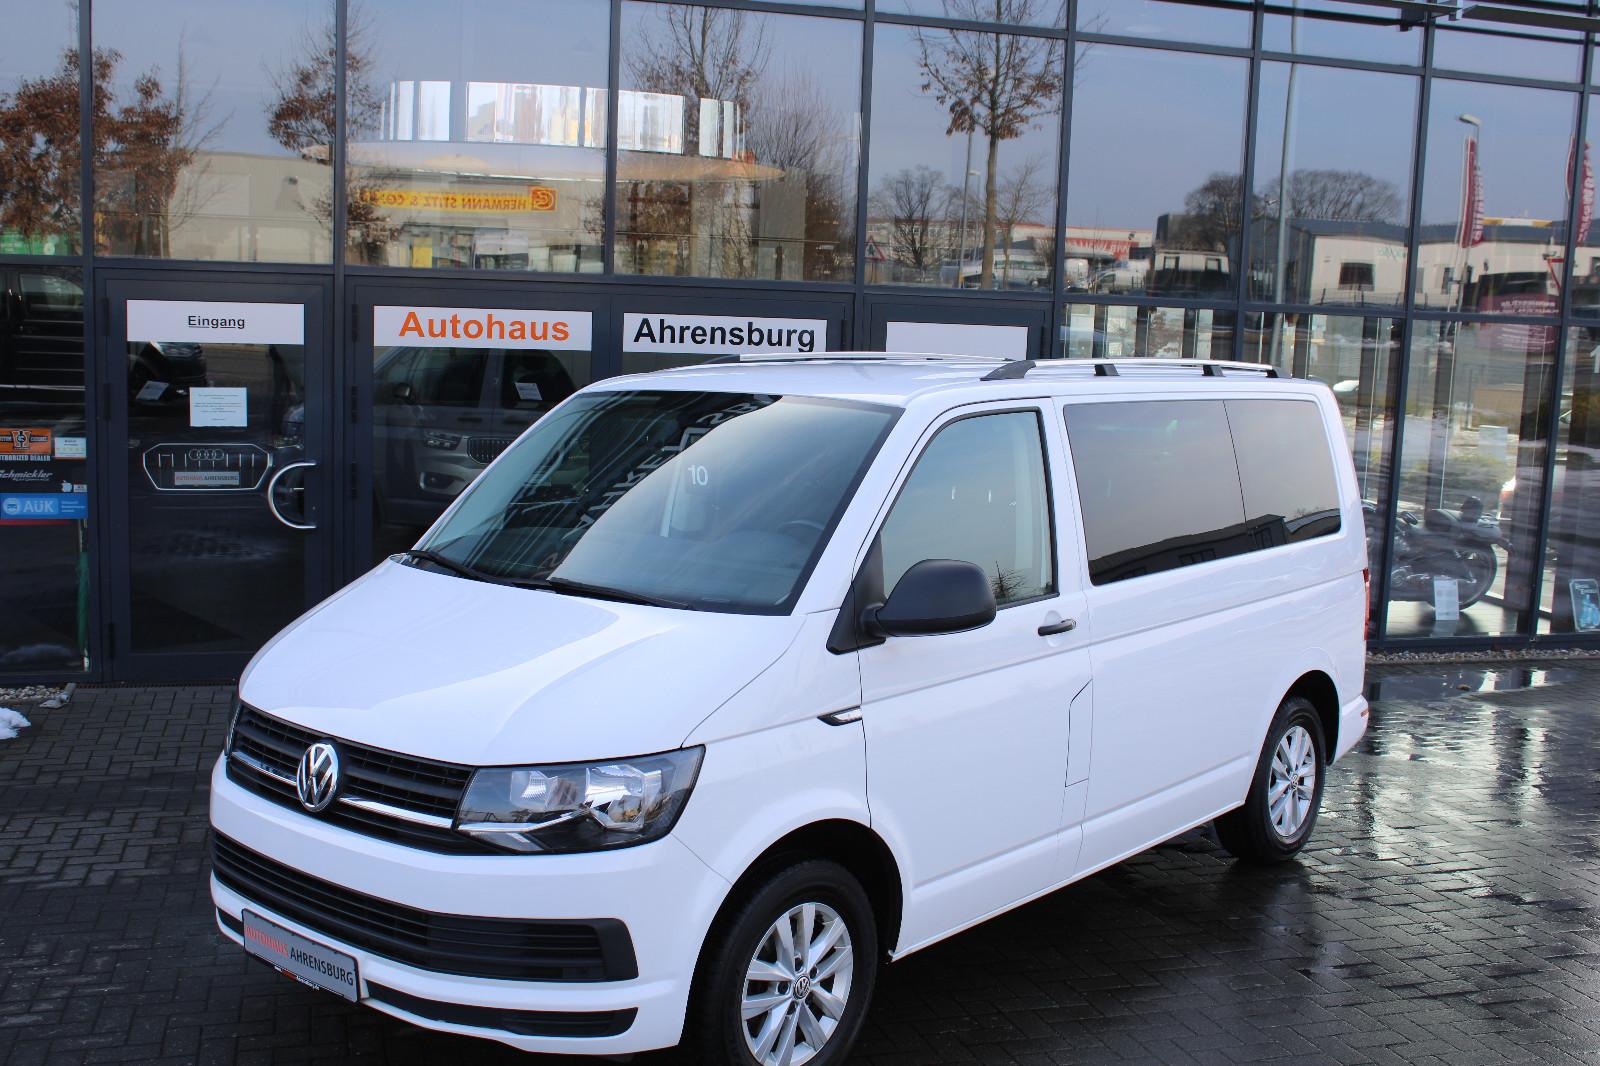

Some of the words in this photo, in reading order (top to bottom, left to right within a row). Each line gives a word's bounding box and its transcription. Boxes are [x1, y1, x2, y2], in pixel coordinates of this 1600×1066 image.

[188, 314, 246, 329] Eingang
[398, 311, 570, 341] Autohaus
[633, 317, 816, 353] Ahrensburg
[688, 464, 709, 486] 10
[23, 499, 54, 513] AÜK
[245, 924, 289, 958] AUTOHAUS
[290, 945, 355, 987] AHRENSBURG
